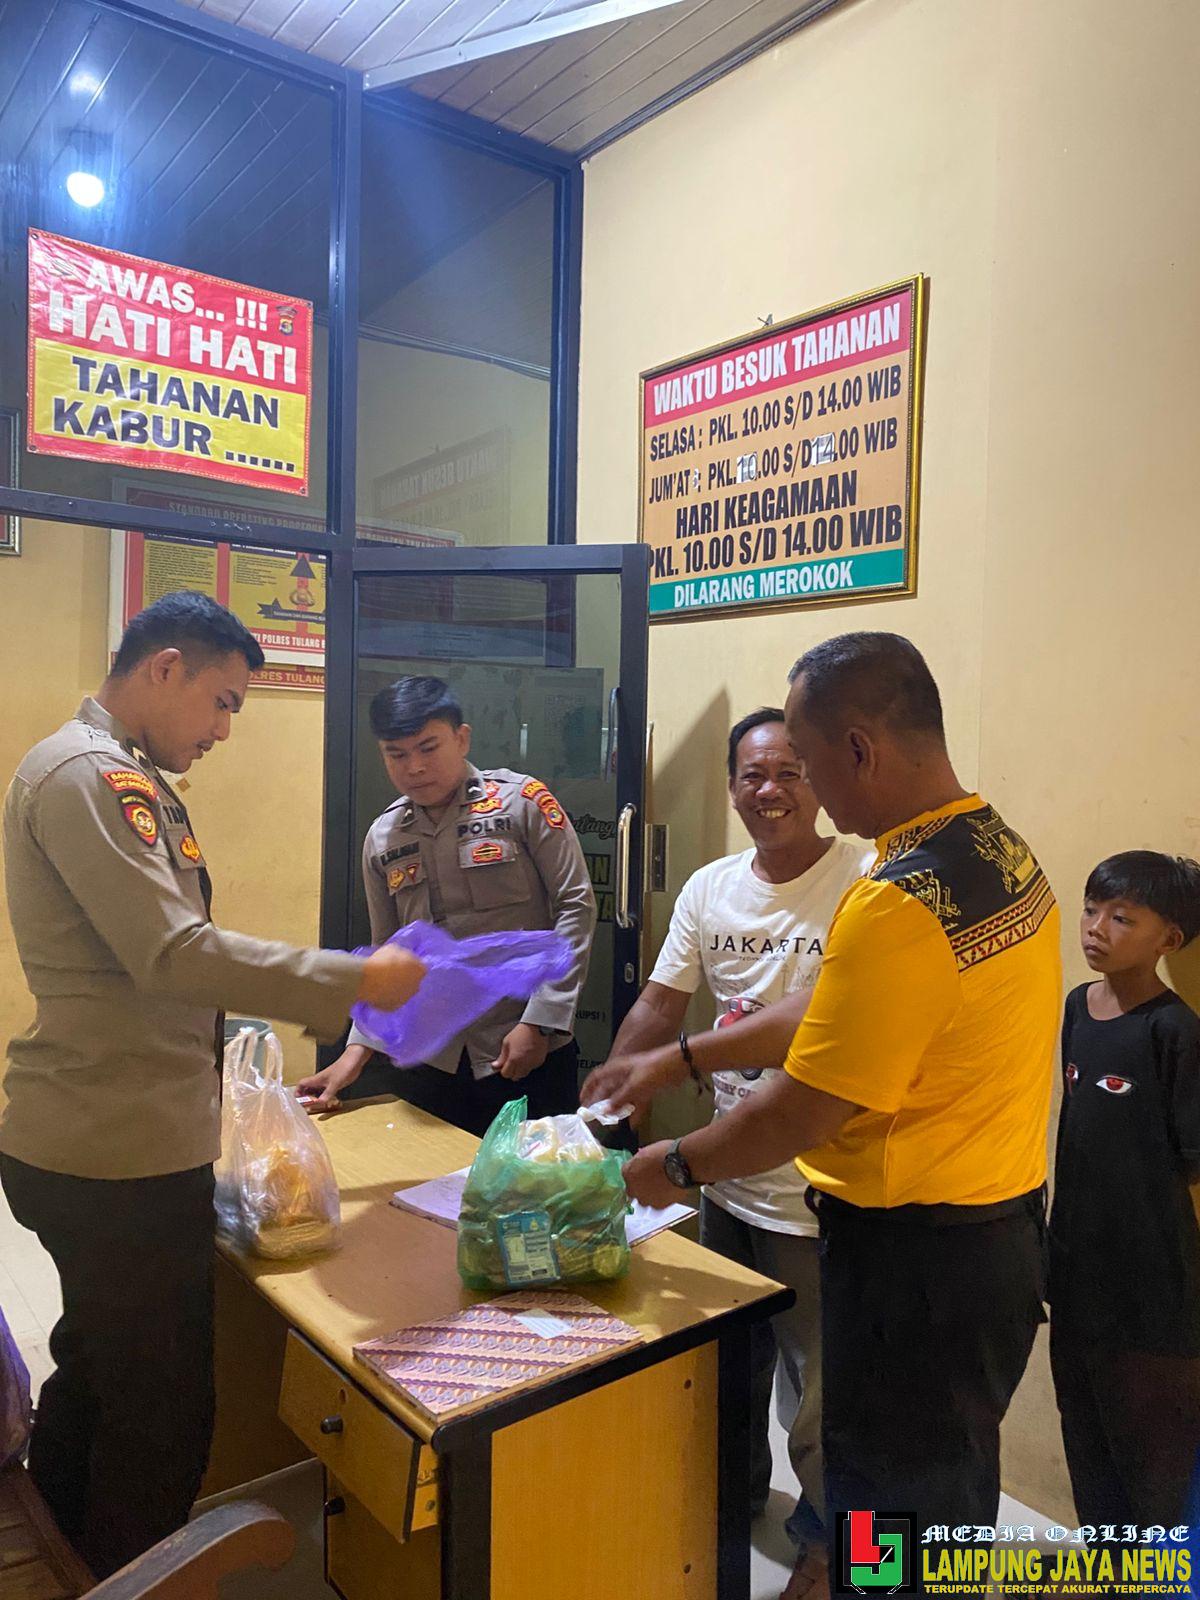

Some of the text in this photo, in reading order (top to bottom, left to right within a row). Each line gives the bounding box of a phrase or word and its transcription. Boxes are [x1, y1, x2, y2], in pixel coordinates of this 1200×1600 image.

[49, 290, 297, 385] HATI HATI
[235, 297, 268, 331] !!!
[654, 303, 901, 416] WAKTU BESUK TAHANAN
[72, 355, 279, 429] TAHANAN
[650, 424, 695, 462] SELASA
[709, 414, 738, 446] PKL.
[742, 400, 780, 436] 10.00
[784, 391, 813, 430] S/D
[818, 375, 862, 417] 14.00
[868, 364, 901, 403] WIB
[54, 397, 212, 456] KABUR
[864, 417, 897, 454] WIB
[676, 470, 857, 539] HARI KEAGAMAAN
[684, 535, 734, 573] 10.00
[740, 528, 776, 564] S/D
[782, 515, 843, 558] 14.00
[850, 504, 902, 548] WIB
[674, 560, 853, 608] DILARANG MEROKOK
[263, 633, 290, 646] POLRES
[292, 636, 320, 649] TULANG
[457, 816, 512, 838] POLRI
[710, 934, 824, 956] JAKARTA
